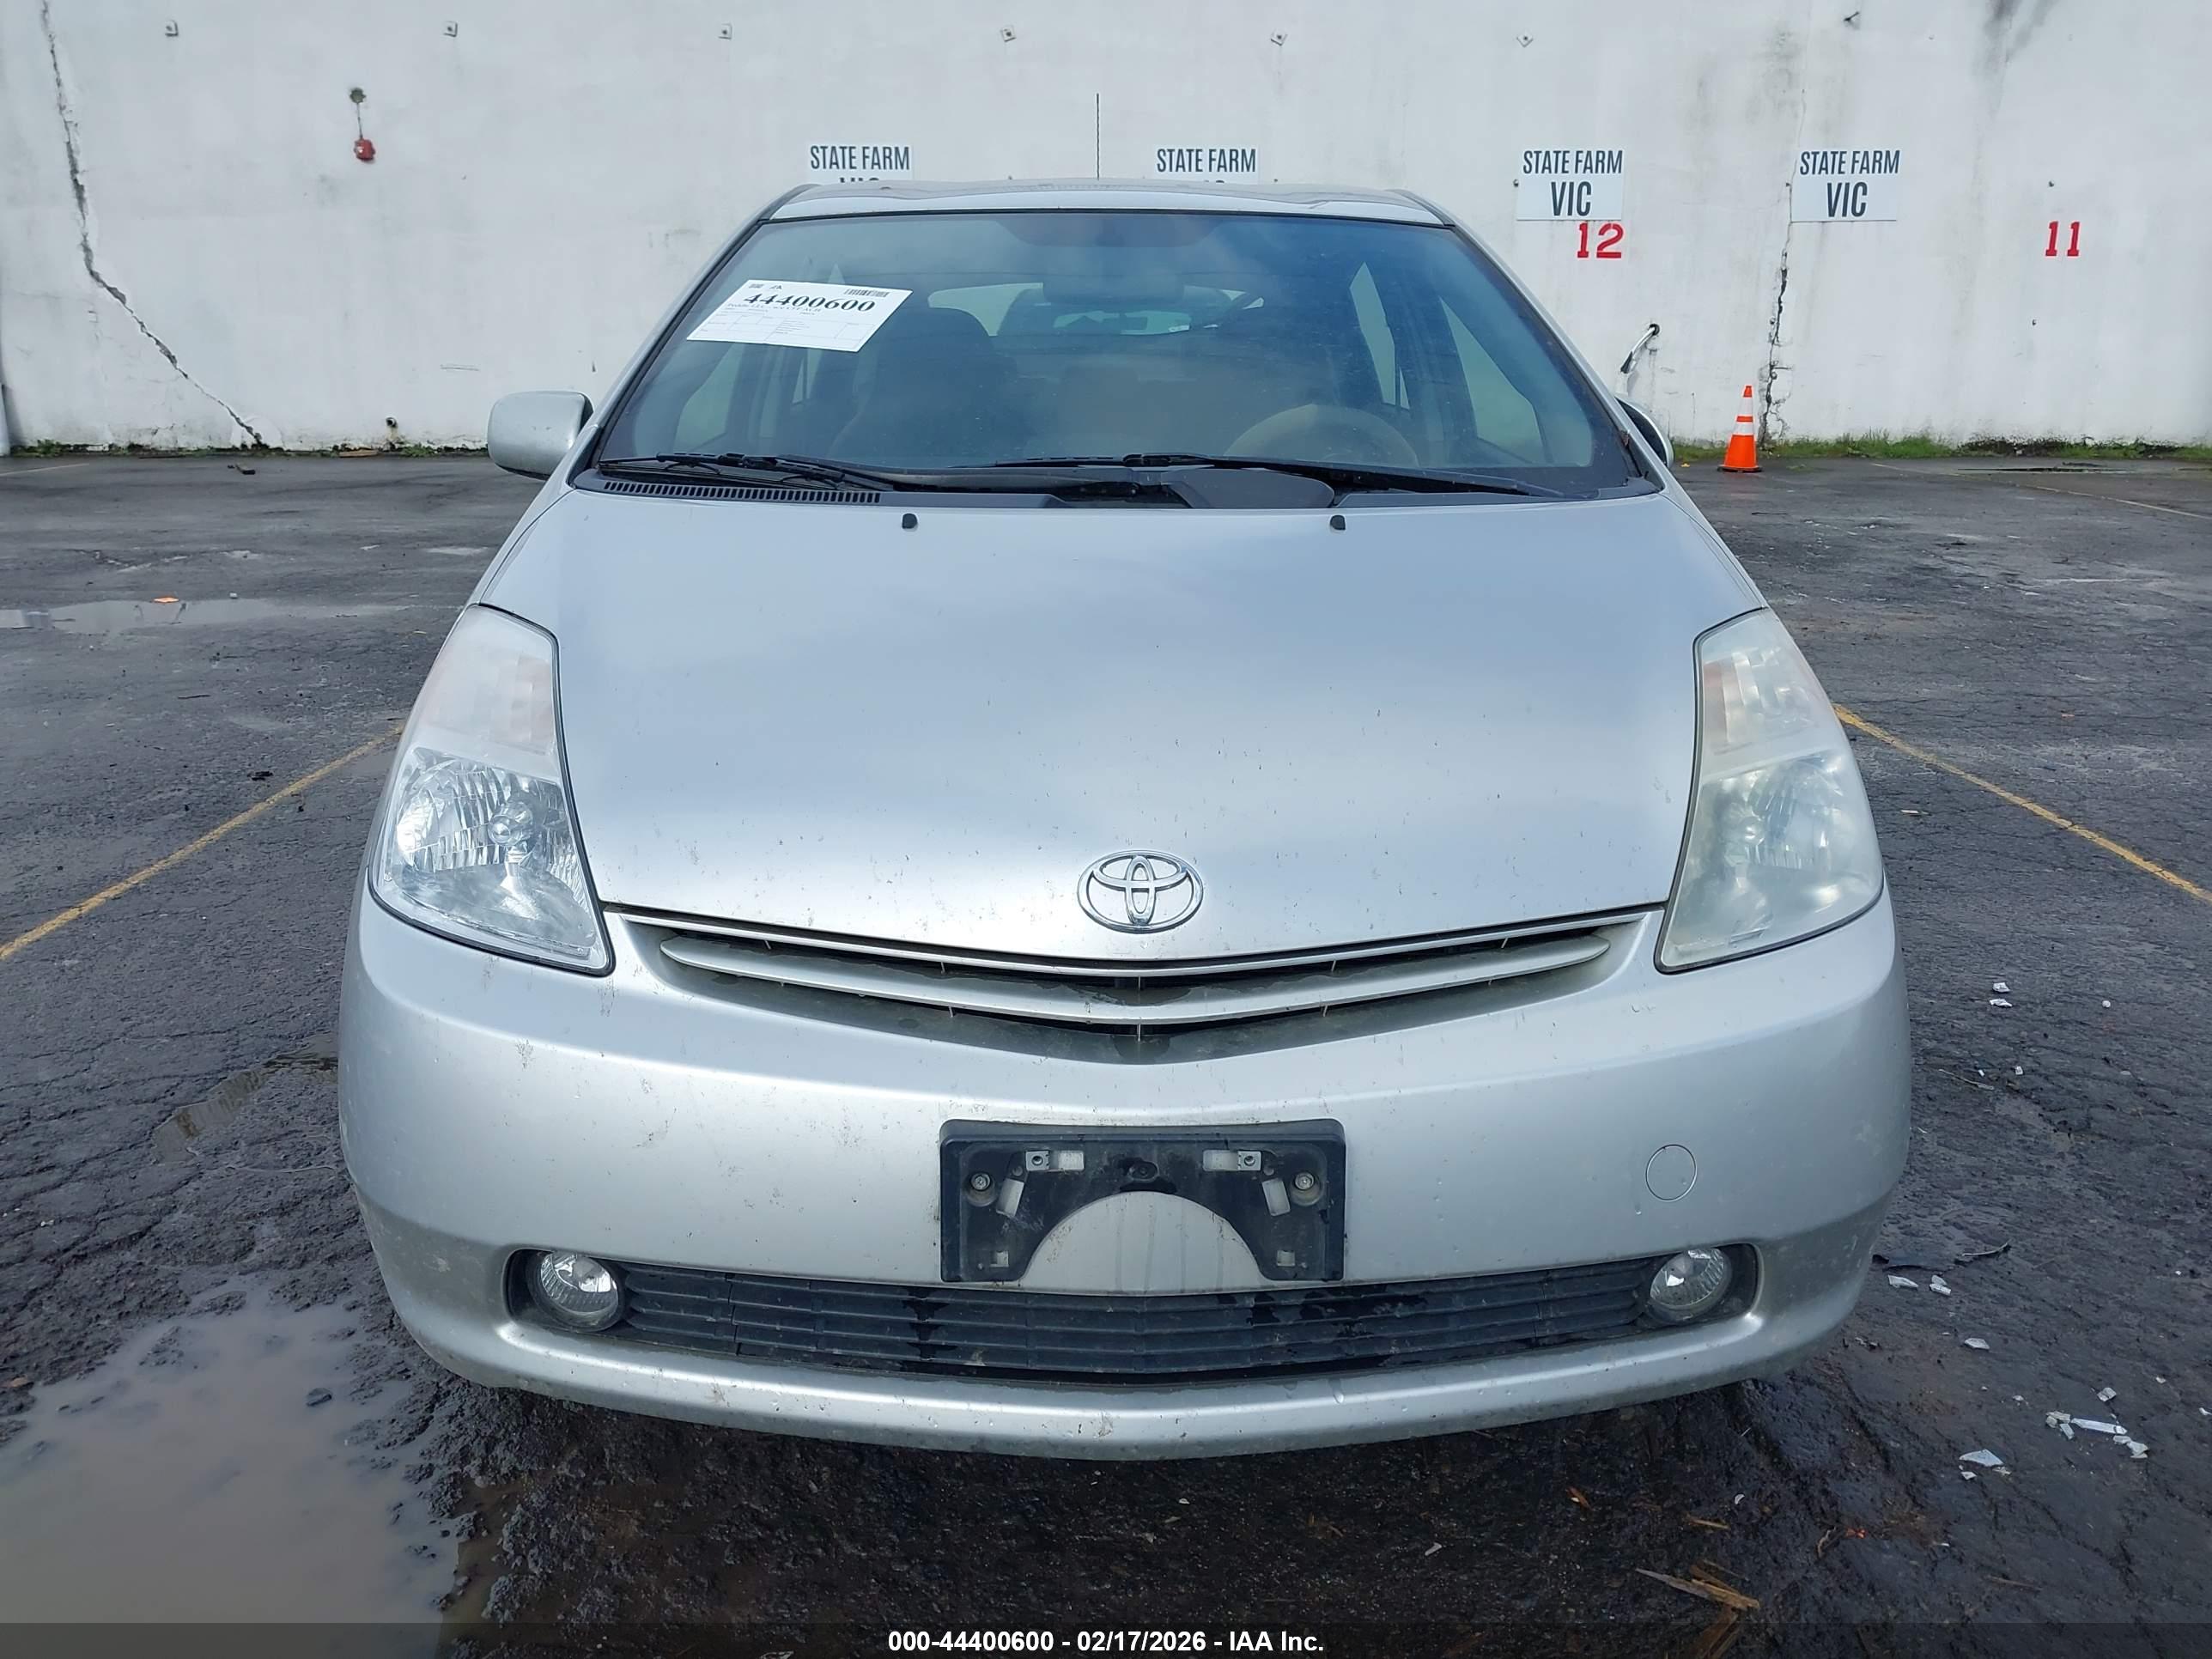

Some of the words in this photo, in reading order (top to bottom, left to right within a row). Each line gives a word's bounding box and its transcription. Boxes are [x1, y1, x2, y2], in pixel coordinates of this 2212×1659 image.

[810, 145, 857, 170] STATE
[862, 146, 909, 170] FARM
[1157, 148, 1203, 173] STATE
[1208, 149, 1256, 173] FARM
[1522, 150, 1571, 175] STATE
[1574, 149, 1623, 174] FARM
[1799, 150, 1847, 175] STATE
[1850, 149, 1900, 174] FARM
[1551, 180, 1592, 216] VIC
[1826, 181, 1868, 218] VIC
[1576, 222, 1626, 260] 12
[2045, 221, 2081, 258] 11
[743, 292, 876, 312] 44400600
